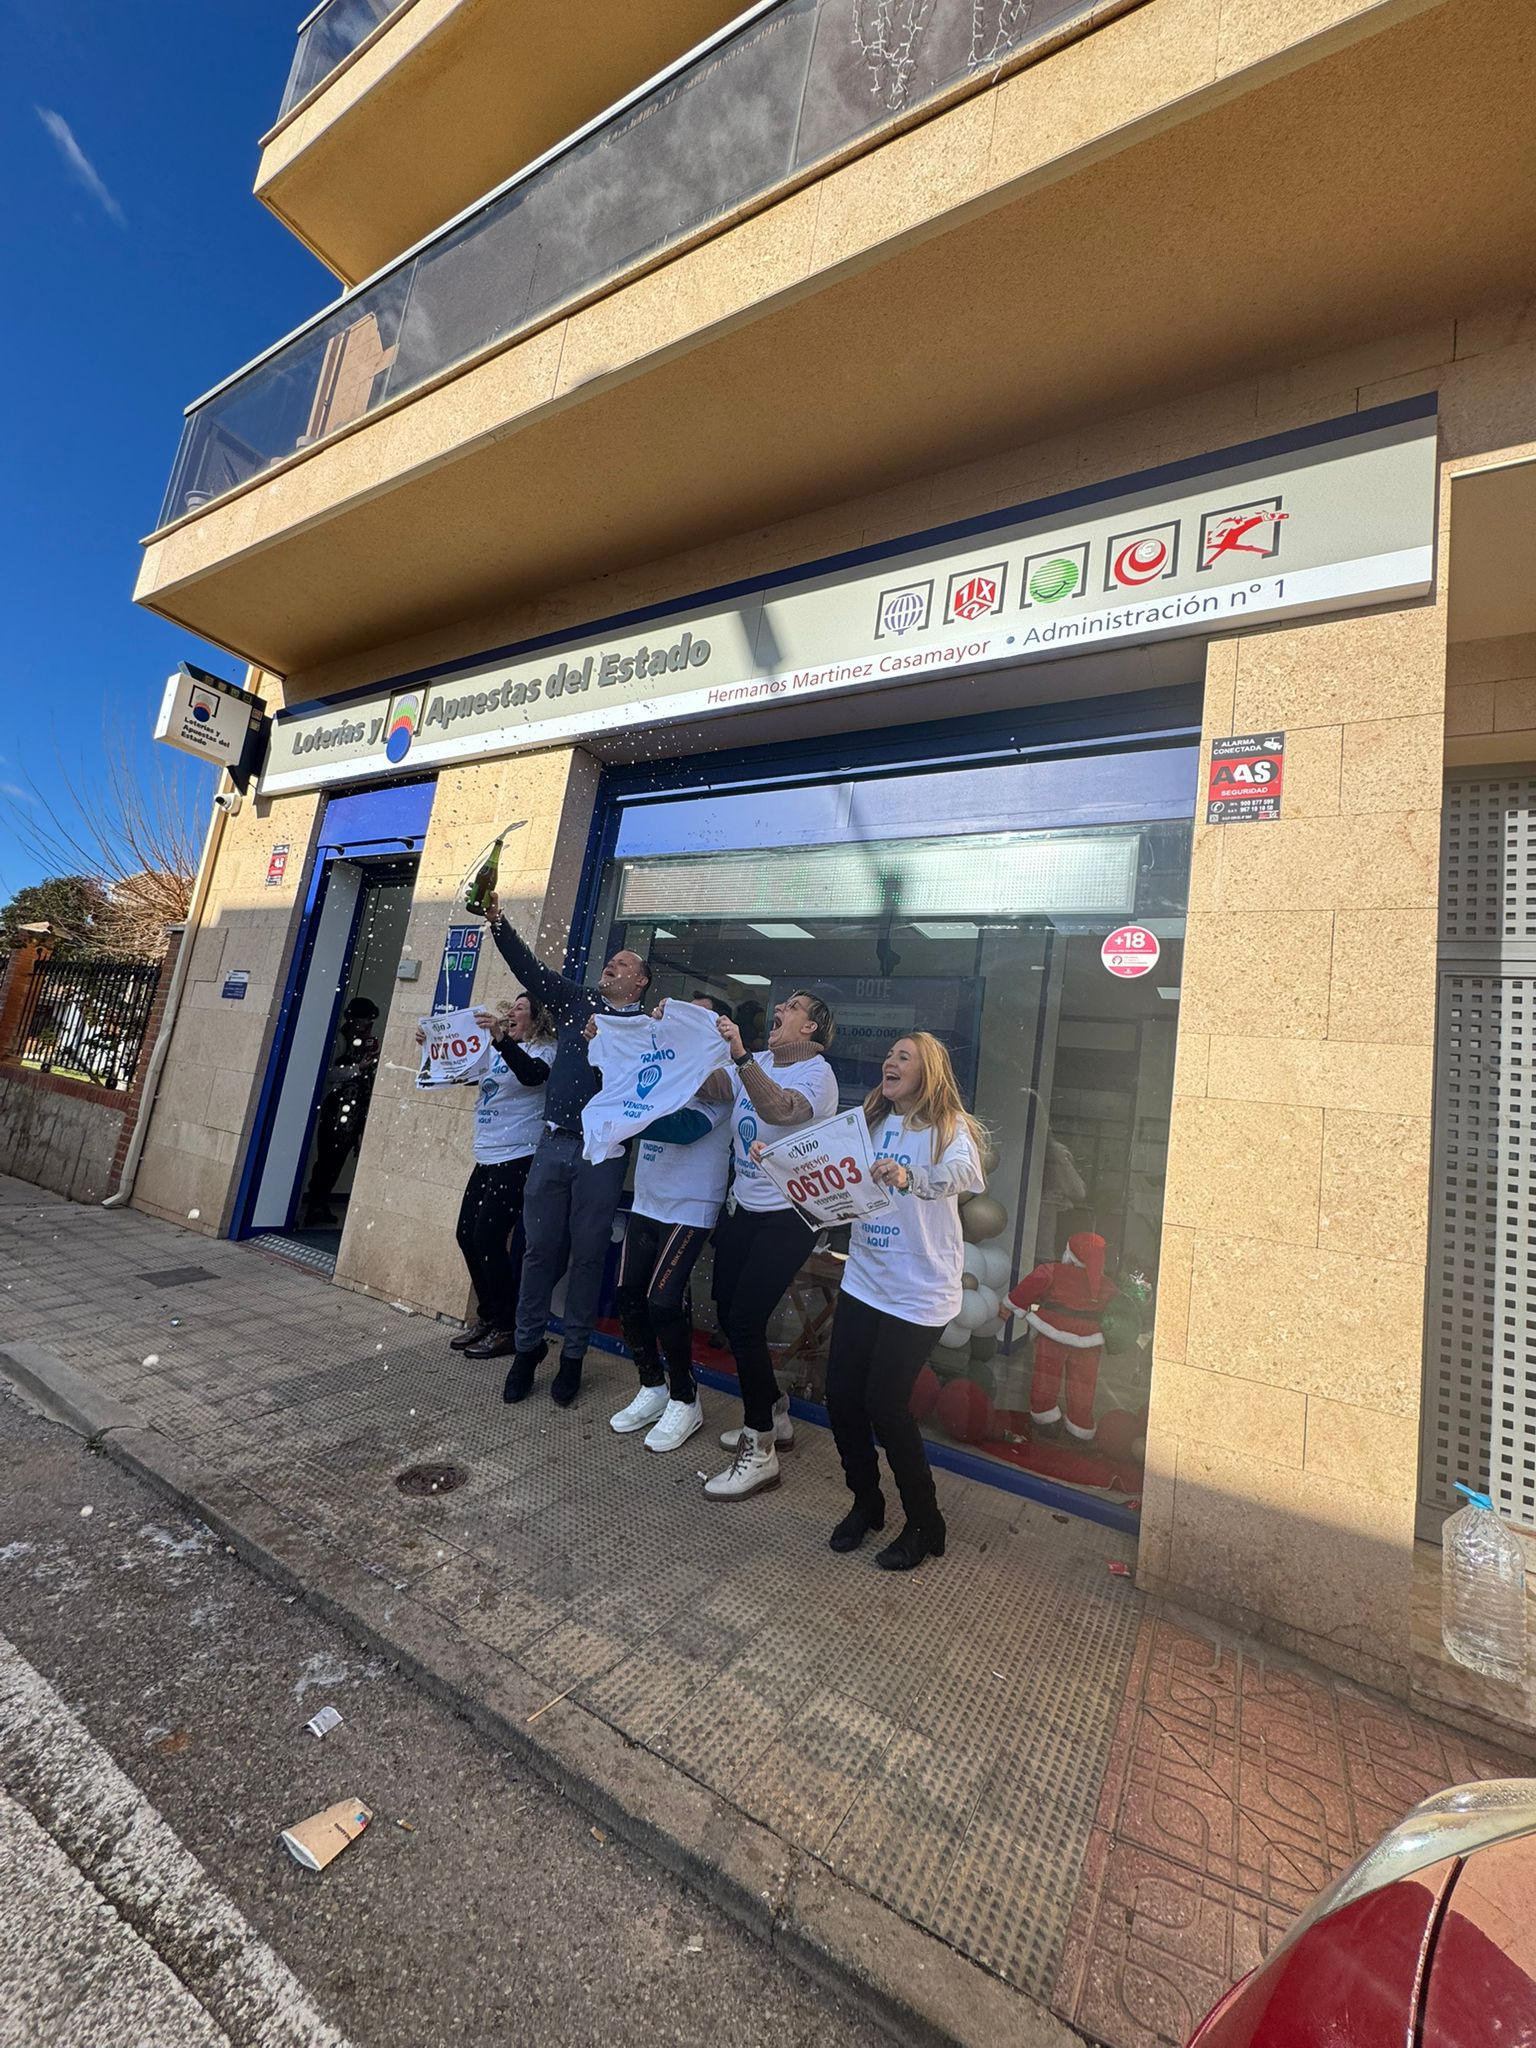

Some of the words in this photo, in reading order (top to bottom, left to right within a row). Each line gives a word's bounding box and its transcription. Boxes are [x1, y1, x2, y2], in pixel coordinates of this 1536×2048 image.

[1023, 594, 1219, 646] Administración
[1274, 579, 1285, 599] 1
[707, 681, 787, 704] Hermanos
[792, 664, 873, 689] Martinez
[879, 640, 991, 674] Casamayor
[292, 719, 365, 755] Loterías
[367, 716, 384, 746] y
[425, 678, 542, 729] Apuestas
[545, 656, 594, 698] del
[599, 632, 711, 688] Estado
[181, 731, 207, 746] Estado
[182, 724, 217, 742] Apuestas
[219, 739, 230, 748] del
[1221, 739, 1256, 748] ALARMA
[1213, 745, 1262, 755] CONECTADA
[1211, 761, 1271, 786] AAS
[1221, 787, 1269, 796] SEGURIDAD
[1114, 931, 1146, 949] +18
[856, 978, 891, 999] BOTE
[786, 1156, 863, 1203] 06703
